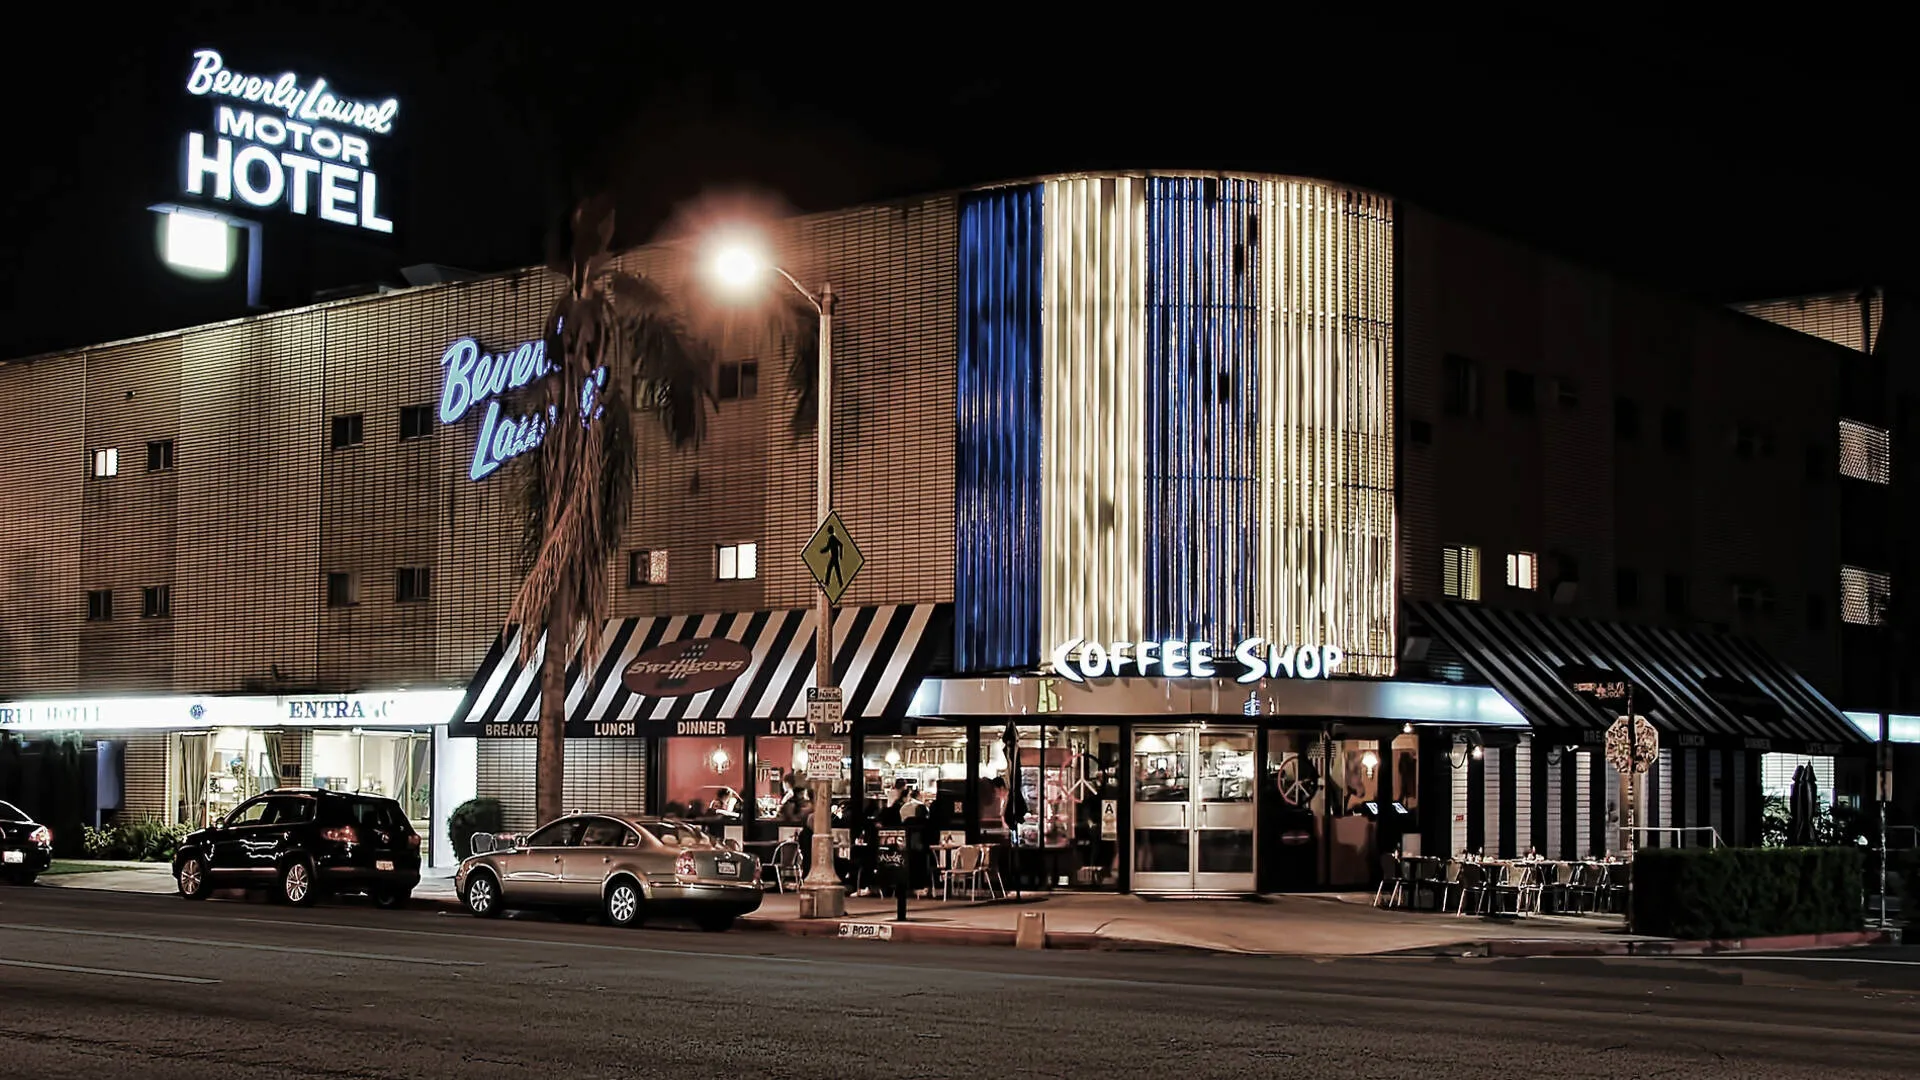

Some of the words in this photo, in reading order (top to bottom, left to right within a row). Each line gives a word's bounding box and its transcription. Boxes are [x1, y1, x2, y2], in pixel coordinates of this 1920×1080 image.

[187, 49, 305, 118] Beverly
[300, 77, 398, 134] Laurel
[218, 106, 369, 167] MOTOR
[186, 131, 394, 234] HOTEL
[1053, 638, 1217, 684] COFFEE
[1234, 637, 1345, 684] SHOP
[809, 688, 816, 699] 2
[288, 699, 394, 719] ENTRA
[485, 723, 539, 737] BREAKFA
[594, 722, 635, 736] LUNCH
[677, 720, 726, 735] DINNER
[770, 720, 805, 735] LATE
[808, 720, 853, 735] NHT
[809, 753, 819, 763] NO
[819, 755, 841, 763] PARKING
